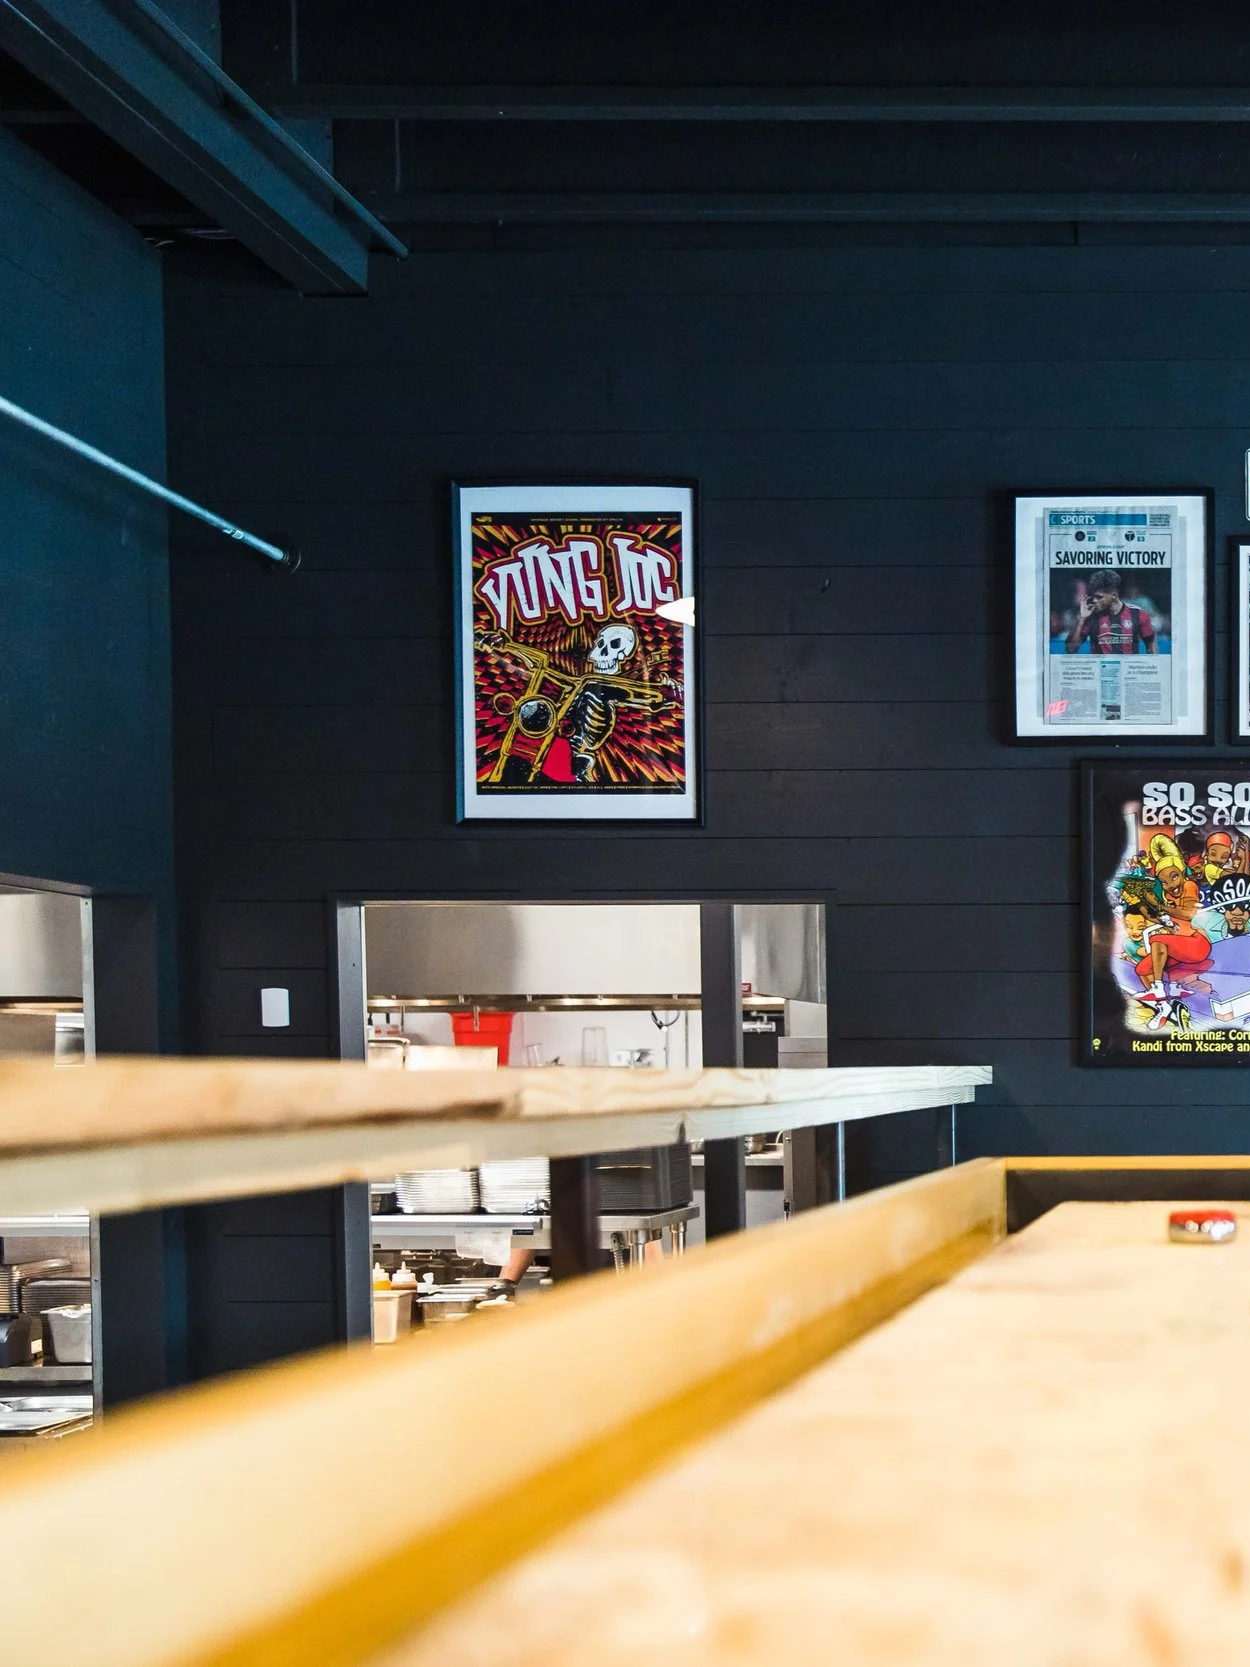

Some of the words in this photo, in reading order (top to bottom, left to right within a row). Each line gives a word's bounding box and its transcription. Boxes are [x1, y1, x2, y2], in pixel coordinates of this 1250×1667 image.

[1060, 515, 1096, 524] SPORTS
[1056, 551, 1112, 565] SAVORING
[1116, 551, 1166, 565] VICTORY
[480, 541, 604, 631] YUNG
[612, 537, 675, 612] JOC
[1142, 782, 1195, 808] so
[1142, 806, 1207, 826] BASS
[1170, 1030, 1226, 1041] Featuring:
[1132, 1040, 1164, 1052] Kandi
[1166, 1040, 1193, 1052] from
[1196, 1041, 1235, 1053] Xscape
